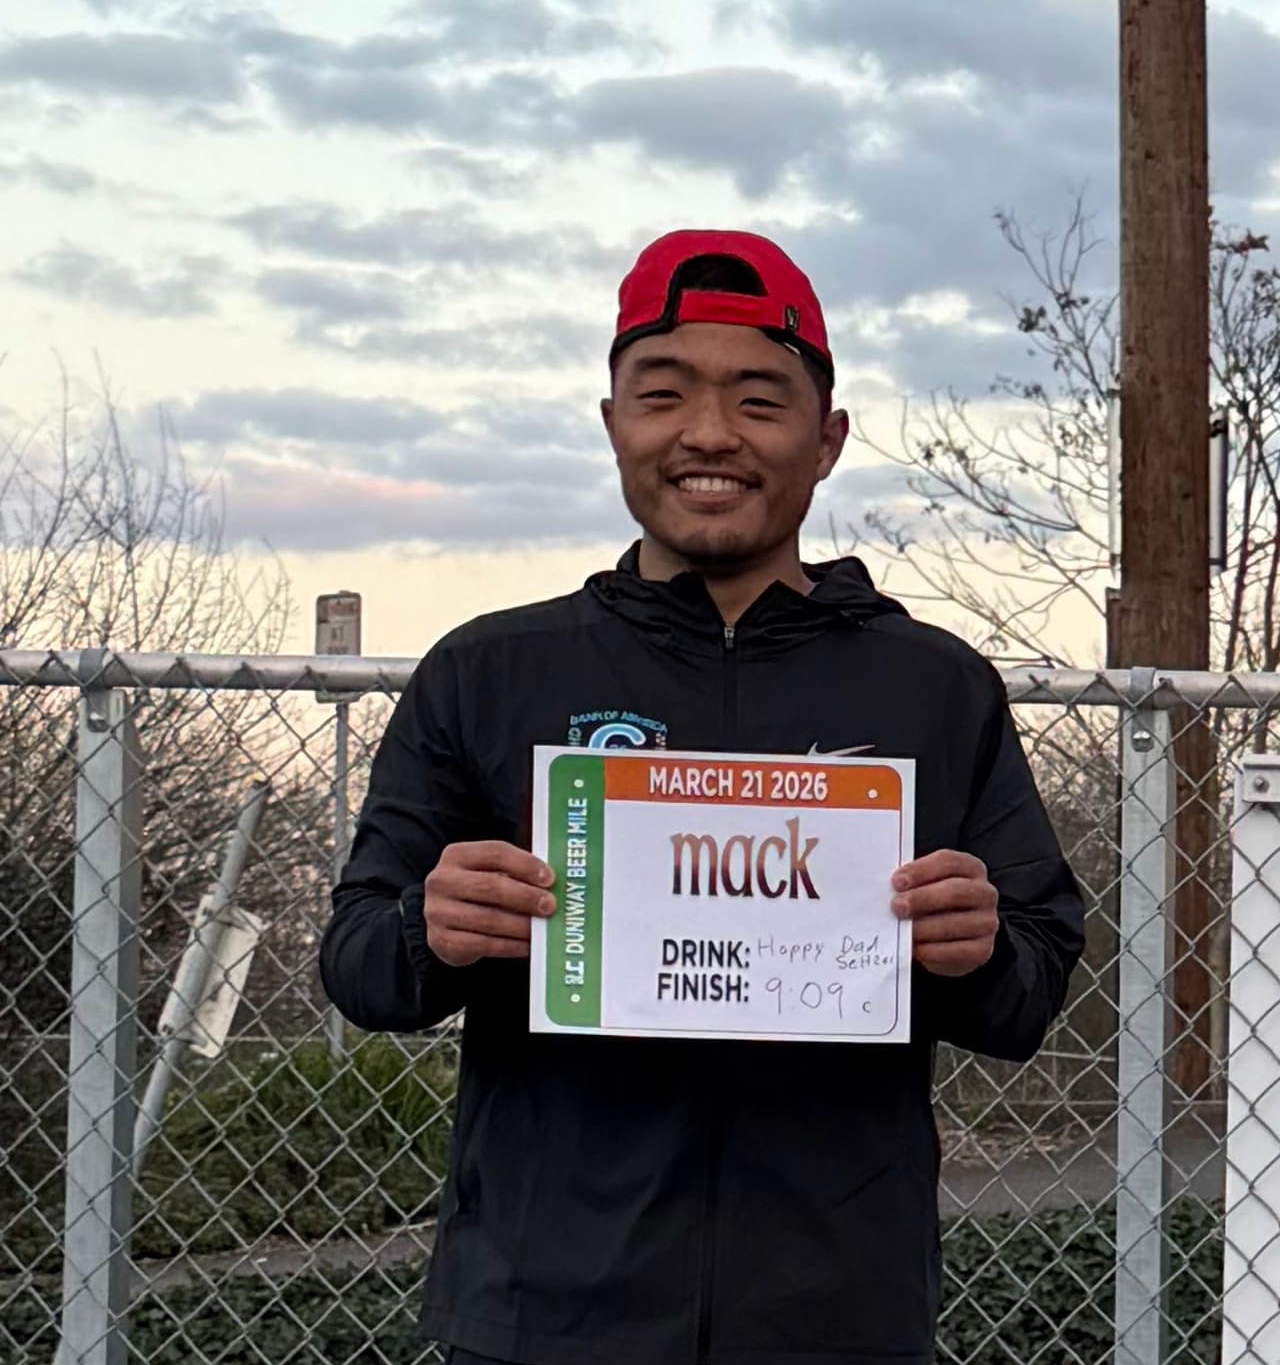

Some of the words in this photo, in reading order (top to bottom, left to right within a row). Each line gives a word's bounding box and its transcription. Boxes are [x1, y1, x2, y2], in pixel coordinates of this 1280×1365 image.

[649, 766, 734, 798] MARCH
[740, 770, 764, 799] 21
[771, 771, 829, 802] 2026
[567, 798, 588, 835] MILE
[567, 838, 587, 878] BEER
[565, 883, 586, 954] DUNIWAY
[662, 938, 750, 970] DRINK:
[657, 972, 750, 1004] FINISH:
